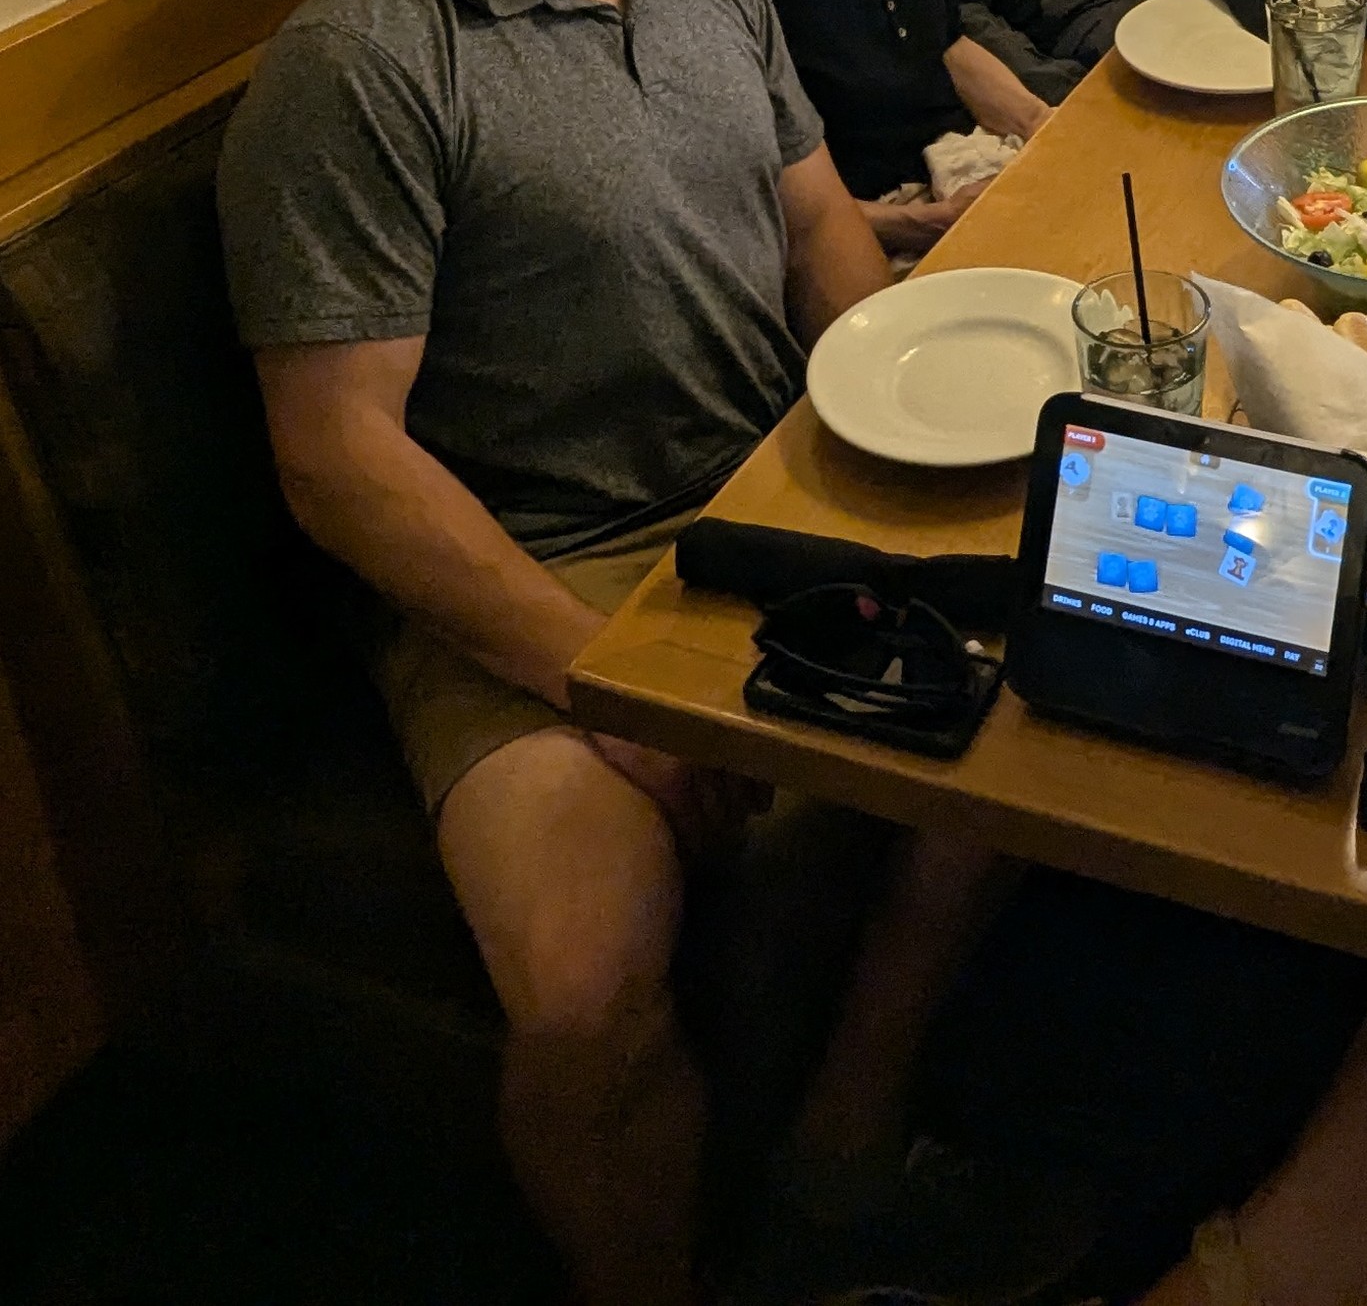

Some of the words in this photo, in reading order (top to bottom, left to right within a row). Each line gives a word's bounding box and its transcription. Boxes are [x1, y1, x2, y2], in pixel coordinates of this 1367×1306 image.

[1052, 594, 1082, 608] DRINKS
[1091, 603, 1113, 616] FOOD
[1121, 611, 1148, 625] GAMES
[1155, 619, 1176, 632] APPS
[1220, 635, 1251, 650] DIGITAL
[1252, 644, 1275, 656] MENU
[1284, 651, 1300, 661] PAY
